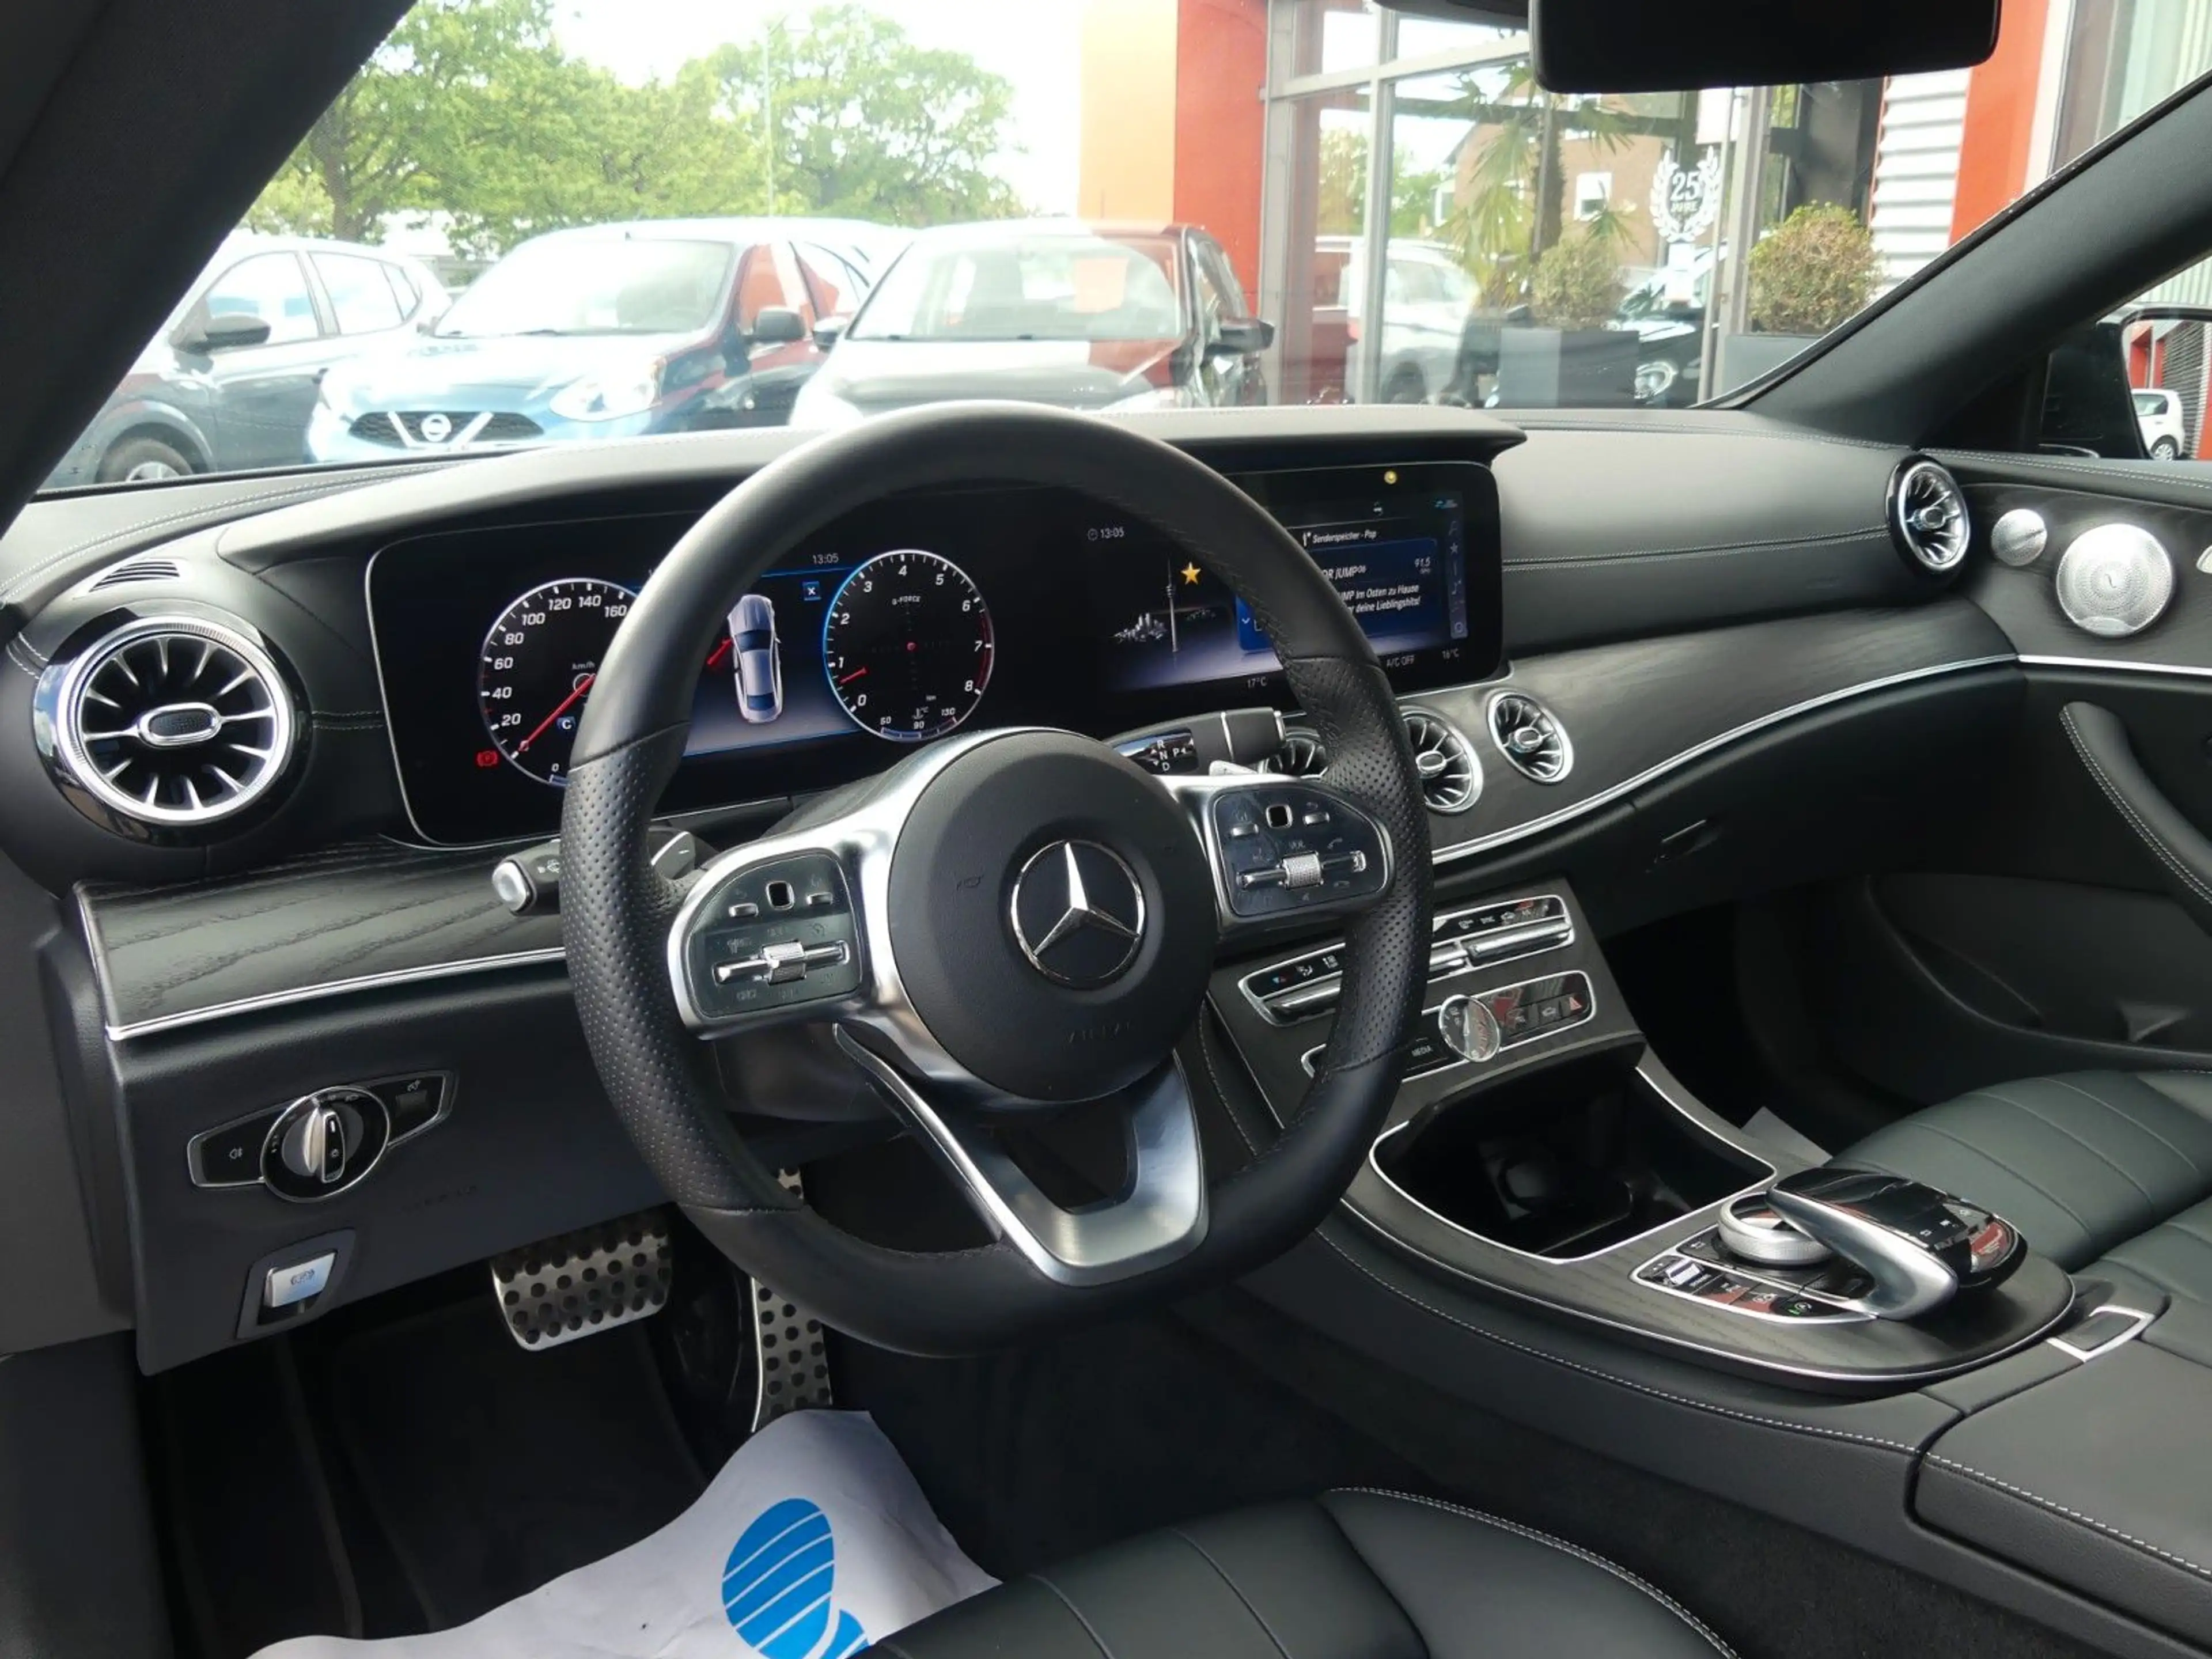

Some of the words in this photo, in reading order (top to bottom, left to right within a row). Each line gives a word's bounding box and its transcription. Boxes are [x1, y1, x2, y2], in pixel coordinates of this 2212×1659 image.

[1670, 171, 1700, 201] 25
[1100, 527, 1124, 539] 13:05
[812, 553, 839, 565] 13:05
[898, 565, 908, 577] 4
[935, 574, 945, 586] 5
[863, 581, 873, 593] 3
[548, 598, 571, 611] 120
[578, 594, 601, 607] 140
[961, 600, 971, 612] 6
[604, 604, 627, 618] 160
[522, 612, 546, 626] 100
[841, 613, 850, 625] 2
[505, 632, 524, 645] 80
[974, 641, 983, 652] 7
[494, 657, 514, 670] 60
[572, 661, 595, 670] km/h
[839, 657, 845, 668] 1
[964, 680, 974, 692] 8
[491, 687, 512, 699] 40
[857, 694, 867, 707] 0
[941, 707, 955, 716] 130
[501, 713, 521, 726] 20
[1156, 740, 1165, 749] R
[1159, 751, 1168, 760] N
[1173, 748, 1179, 757] P
[1162, 762, 1170, 772] D
